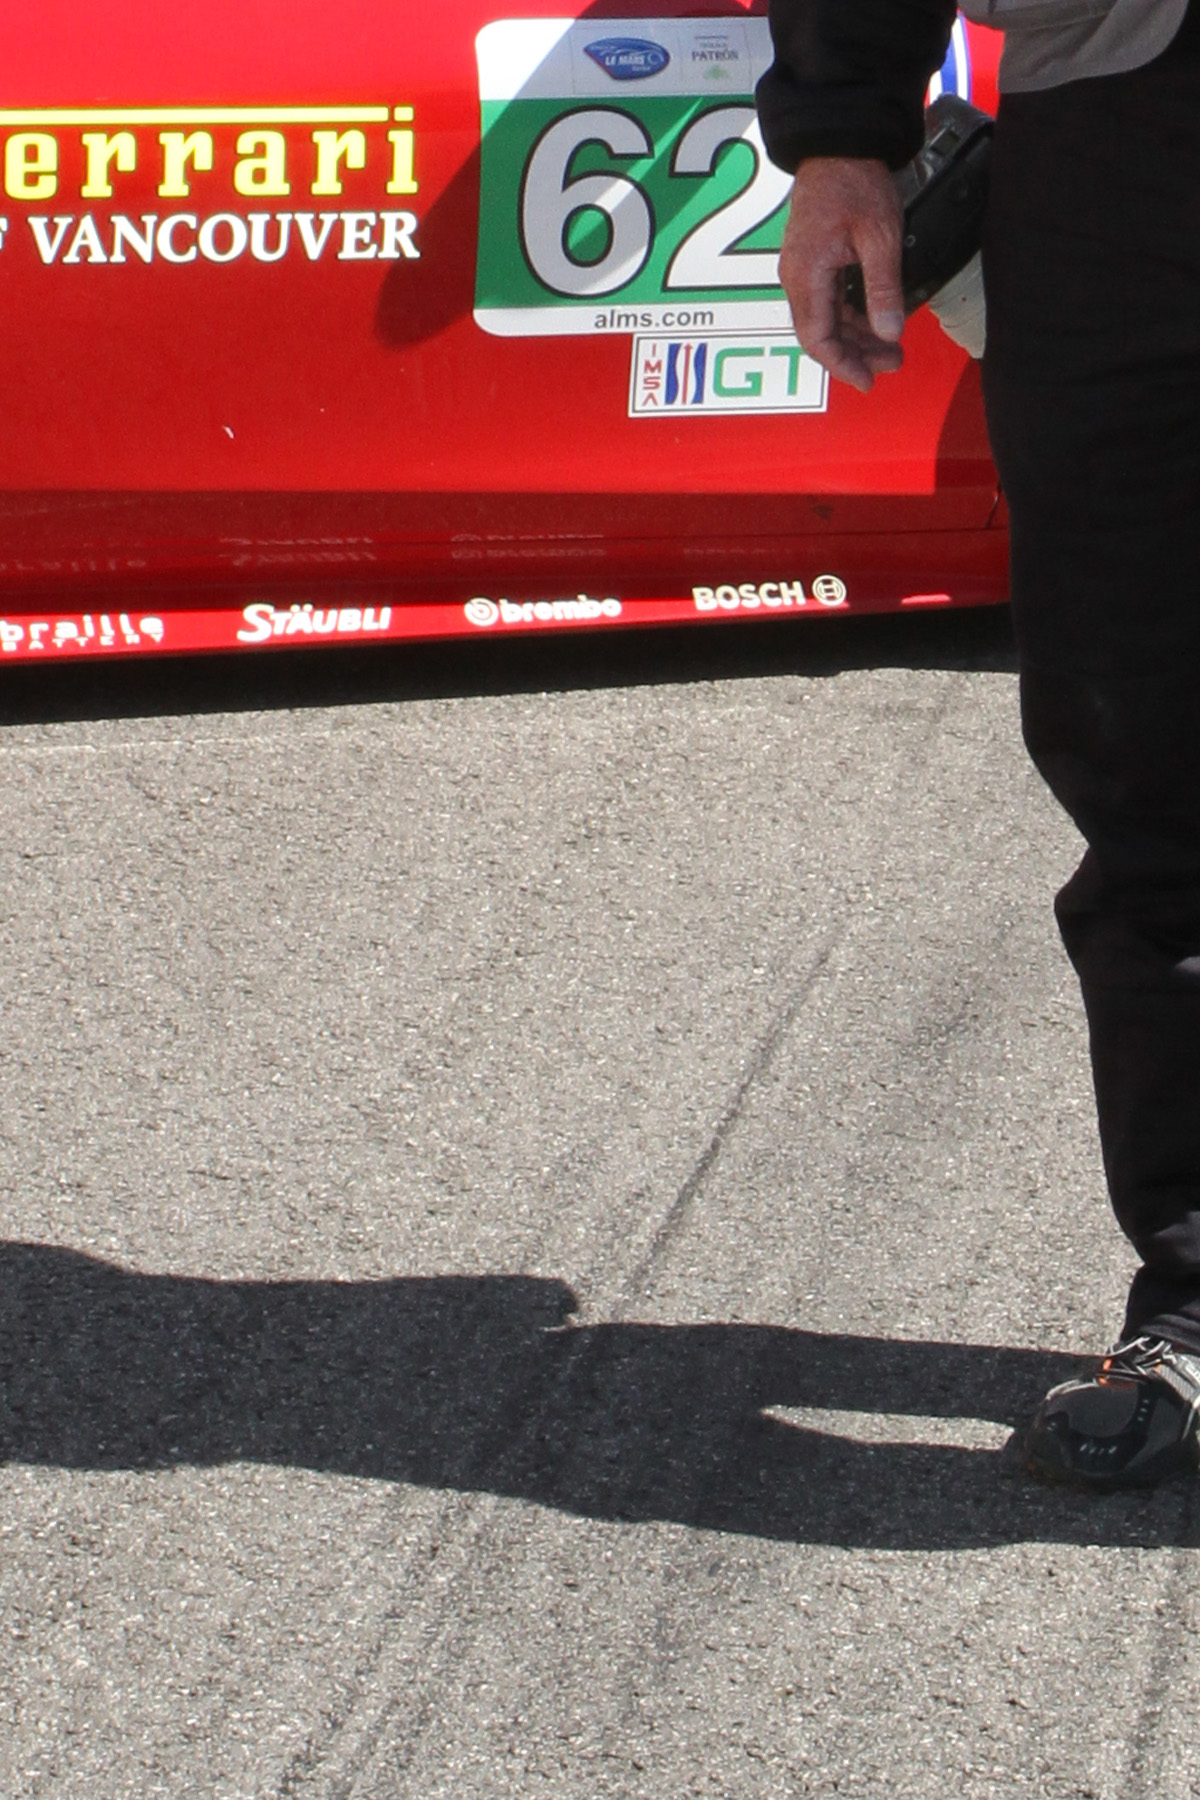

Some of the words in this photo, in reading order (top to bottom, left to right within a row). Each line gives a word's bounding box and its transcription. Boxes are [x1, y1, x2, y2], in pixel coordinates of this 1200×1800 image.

[0, 106, 419, 201] errari
[518, 102, 793, 300] 62
[27, 210, 421, 265] VANCOUVER
[594, 309, 714, 329] alms.com
[713, 345, 807, 398] GT
[500, 595, 622, 624] brembo
[692, 580, 806, 611] BOSCH
[0, 613, 164, 643] braille
[1, 633, 164, 651] BATTERY
